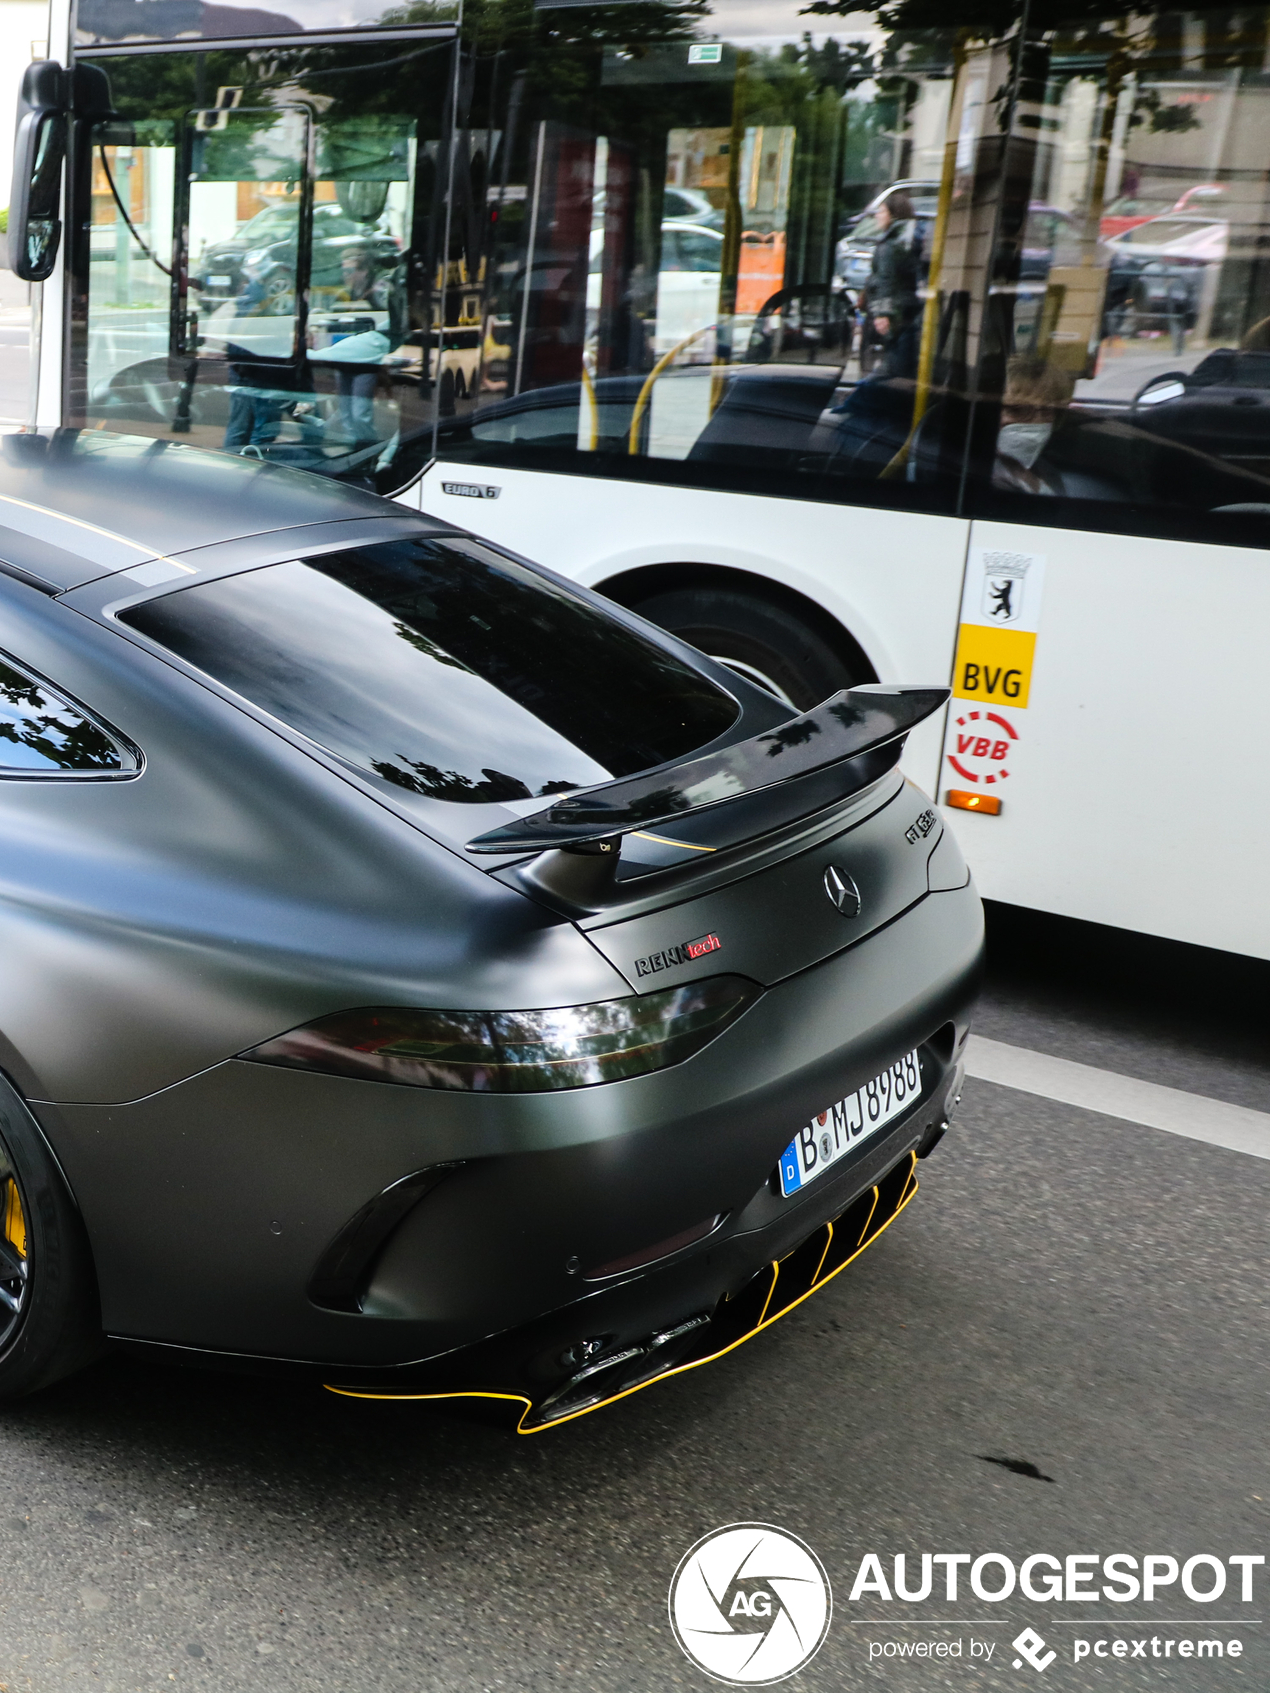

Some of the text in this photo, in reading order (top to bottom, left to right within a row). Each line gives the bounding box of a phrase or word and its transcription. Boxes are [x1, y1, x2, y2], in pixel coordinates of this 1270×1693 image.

[444, 483, 496, 498] EURO 6
[963, 662, 1023, 698] BVG
[957, 733, 1010, 761] VBB
[800, 1121, 818, 1173] B
[787, 1165, 795, 1181] D
